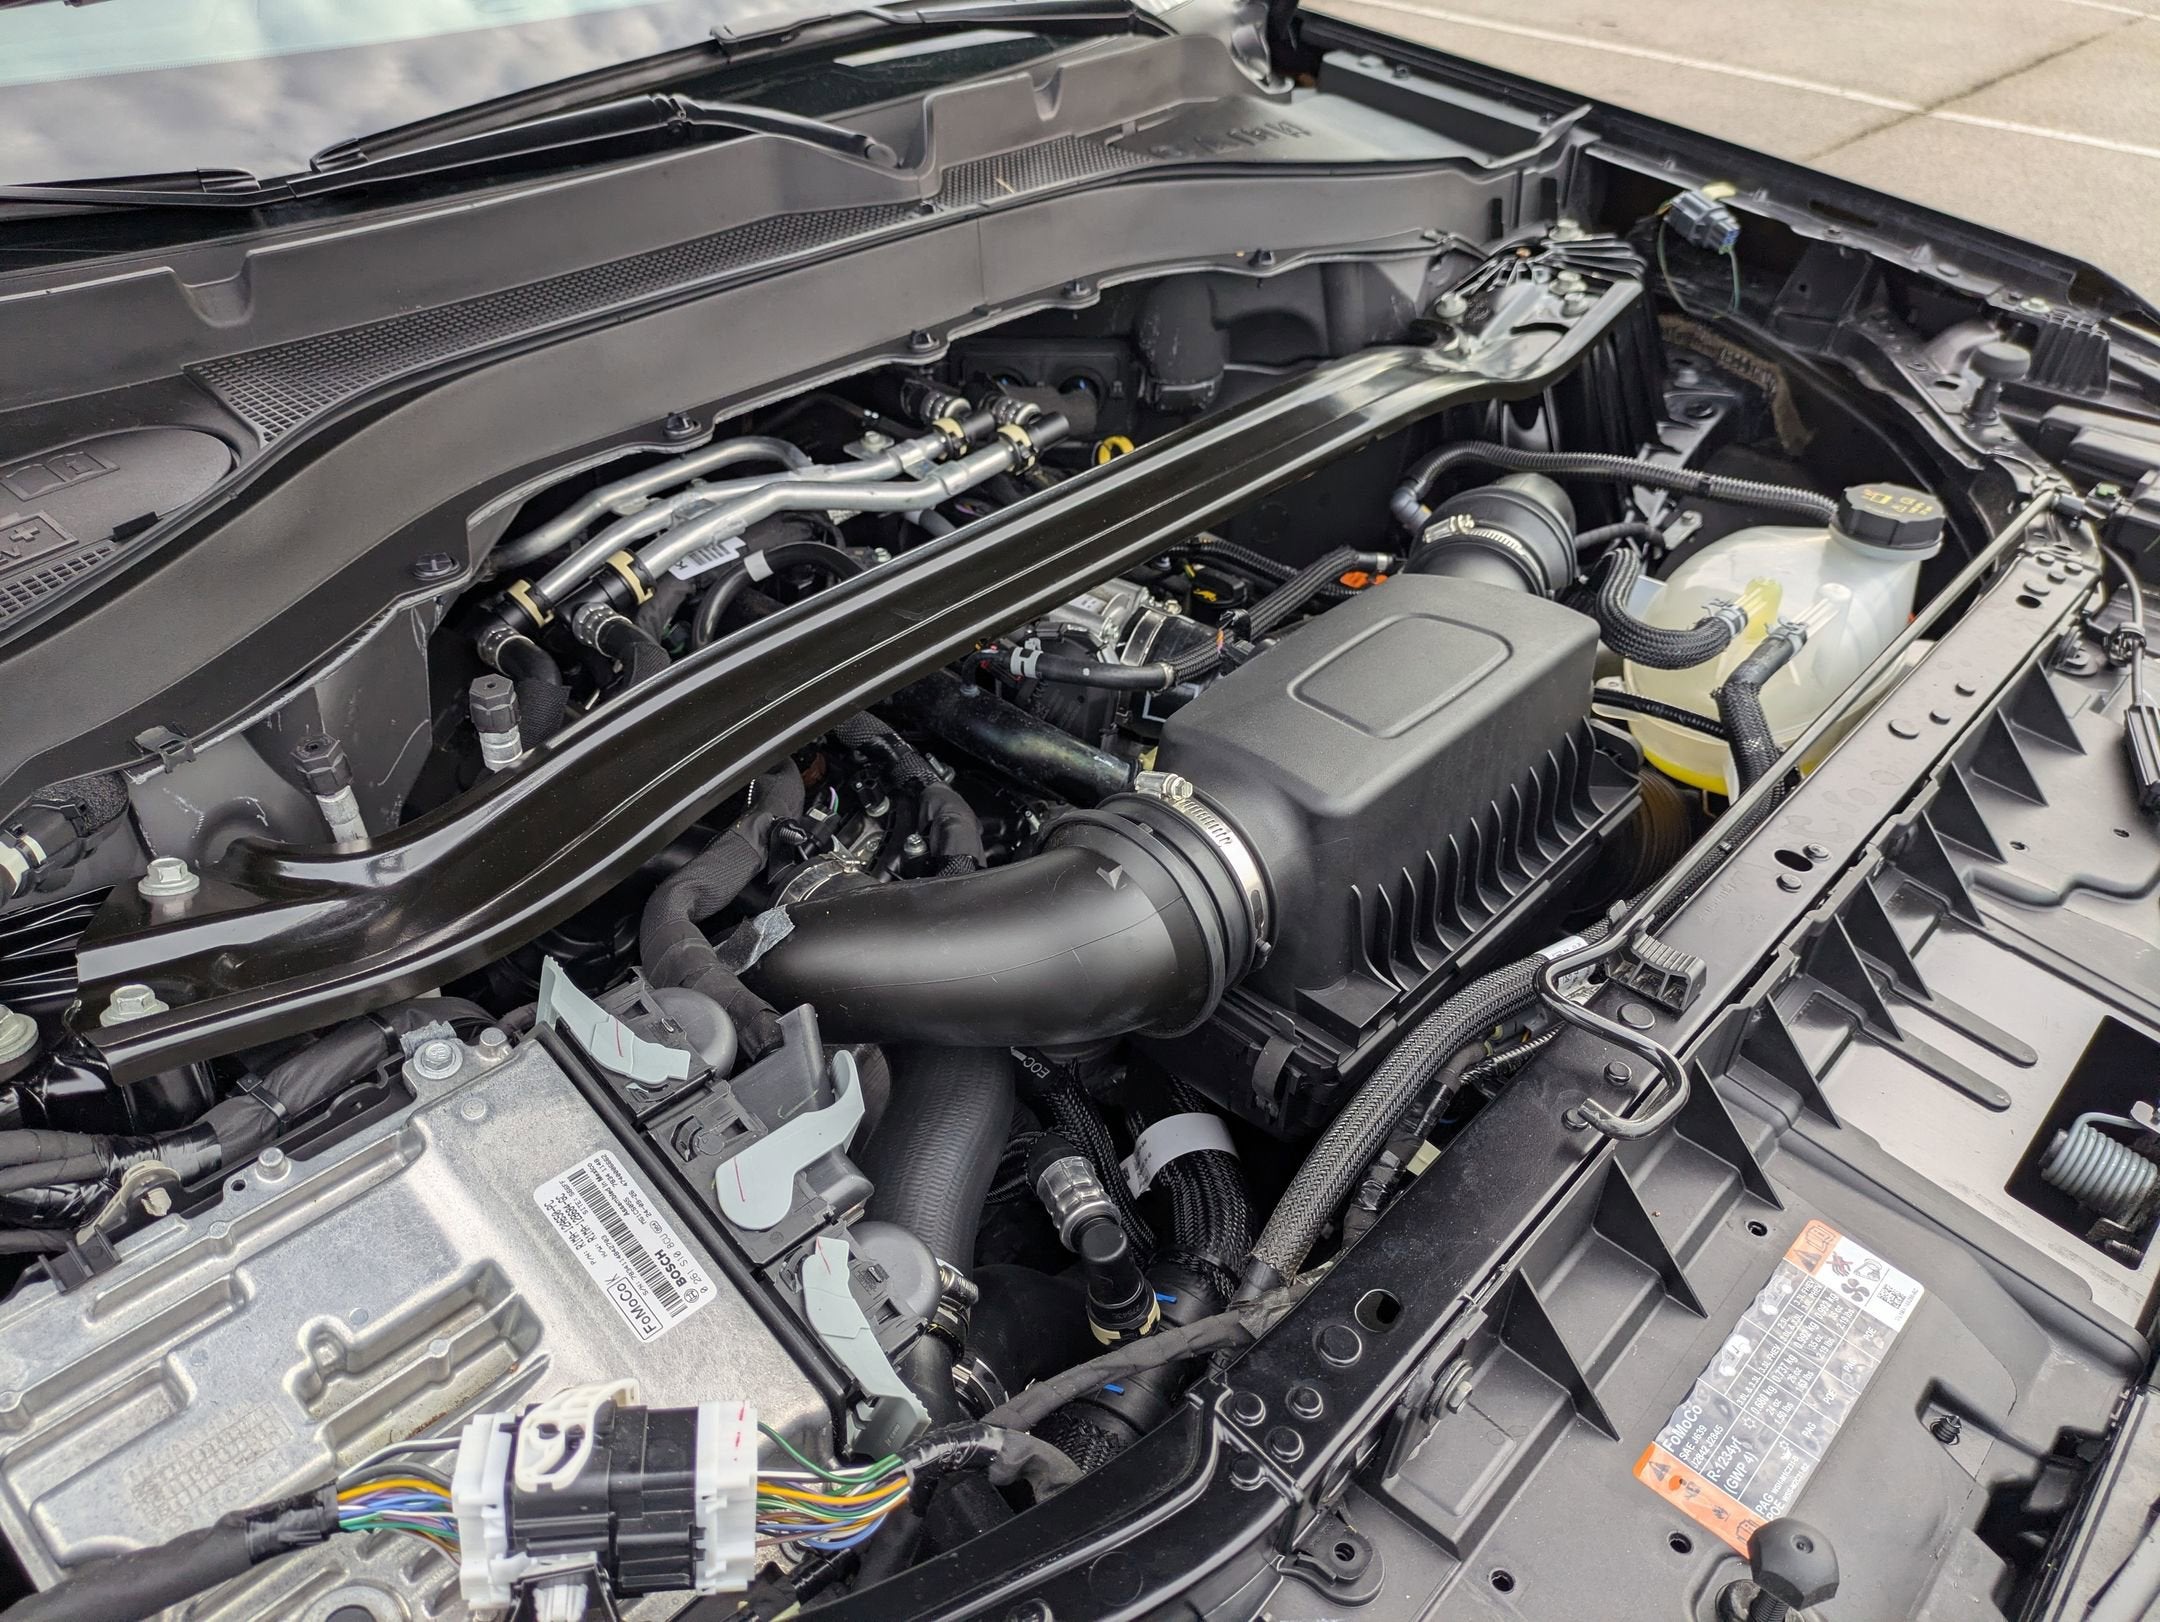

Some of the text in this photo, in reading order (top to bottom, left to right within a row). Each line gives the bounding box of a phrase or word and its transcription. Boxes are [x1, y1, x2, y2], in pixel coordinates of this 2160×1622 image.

[1023, 1057, 1050, 1078] EOC
[587, 1163, 604, 1183] Mexico
[604, 1187, 630, 1217] Assembled
[659, 1233, 675, 1250] 8CU
[654, 1249, 687, 1288] BOSCH
[687, 1269, 703, 1285] 261
[616, 1283, 657, 1334] FoMoCo
[1813, 1291, 1841, 1320] 0.992 kg
[1834, 1305, 1844, 1314] oz
[1835, 1308, 1855, 1330] 2.19 lbs
[1792, 1321, 1820, 1350] 0.992 kg
[1808, 1334, 1824, 1350] 35 oz
[1862, 1326, 1877, 1342] POE
[1766, 1343, 1781, 1362] FHEV
[1816, 1336, 1836, 1360] 2.19 lbs
[1771, 1354, 1799, 1383] 0.737 kg
[1793, 1367, 1803, 1377] oz
[1802, 1370, 1815, 1382] lbs
[1750, 1385, 1778, 1415] 0.680 kg
[1765, 1398, 1782, 1416] 24 oz
[1822, 1388, 1838, 1406] POE
[1774, 1402, 1795, 1425] 1.50 lbs
[1662, 1400, 1703, 1453] FoMoCo
[1801, 1422, 1817, 1439] PAG
[1679, 1425, 1708, 1461] SAE J639
[1690, 1424, 1724, 1469] J2842 J2845
[1707, 1435, 1746, 1482] R-1234yf
[1723, 1451, 1760, 1495] (GWP 4)
[1755, 1492, 1774, 1515] PAG
[1764, 1498, 1787, 1522] POE
